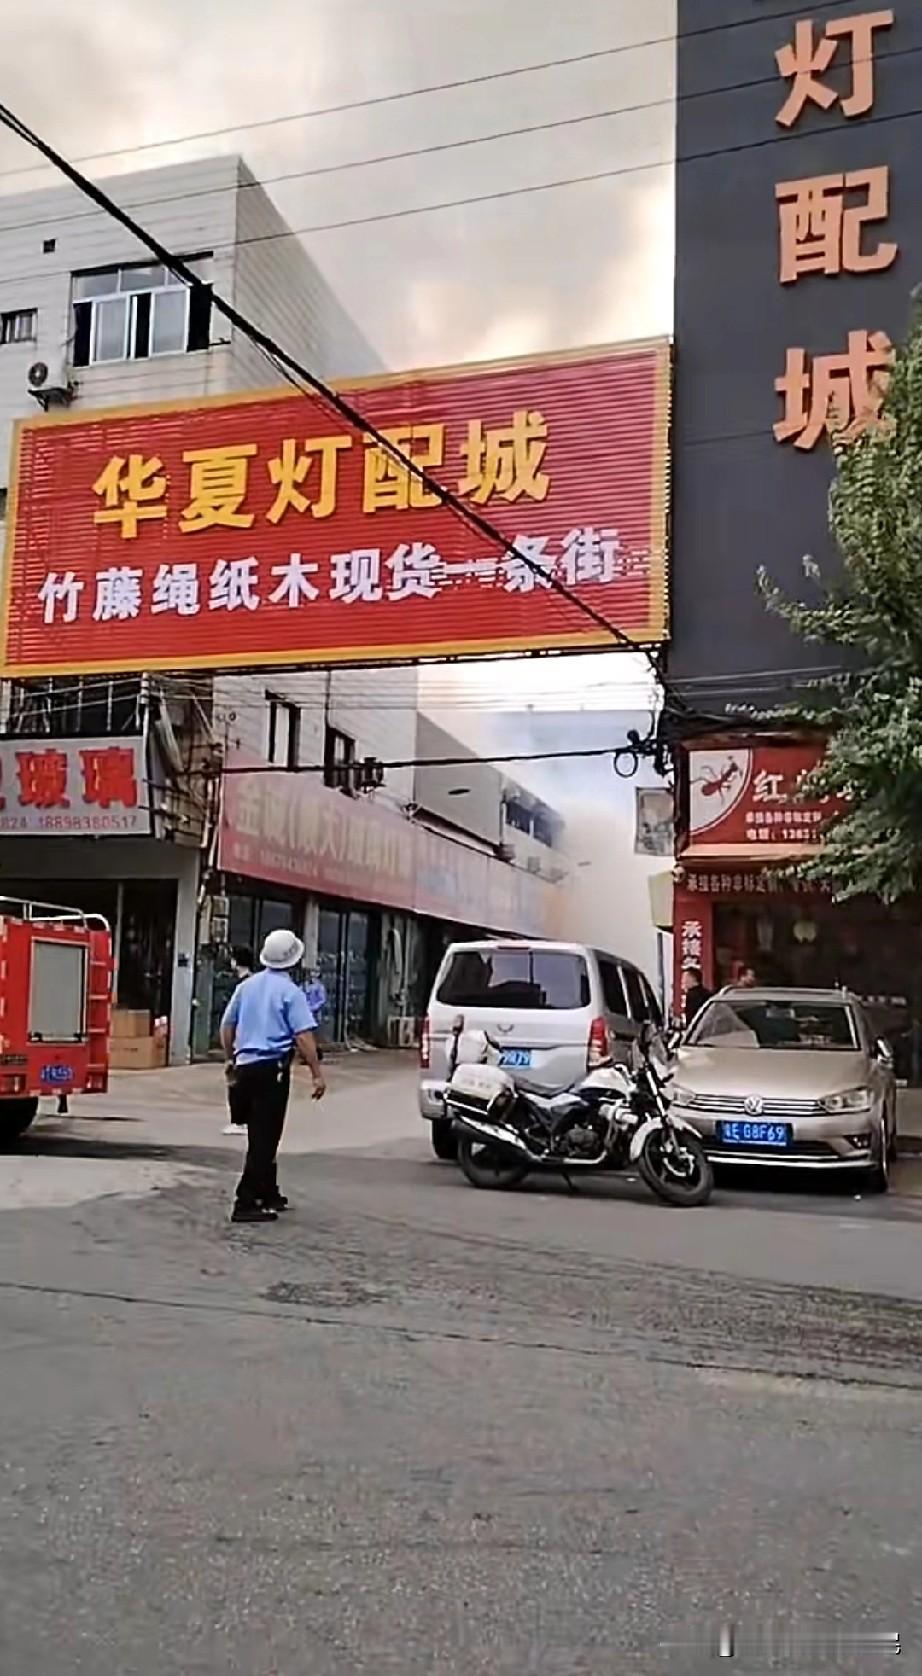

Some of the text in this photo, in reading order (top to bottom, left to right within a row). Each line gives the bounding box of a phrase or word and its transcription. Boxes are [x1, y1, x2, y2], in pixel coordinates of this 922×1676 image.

[774, 9, 897, 450] 灯配城
[93, 409, 550, 539] 华夏灯配城
[38, 526, 622, 624] 竹藤绳纸木现货一条街
[0, 746, 137, 809] 玻璃
